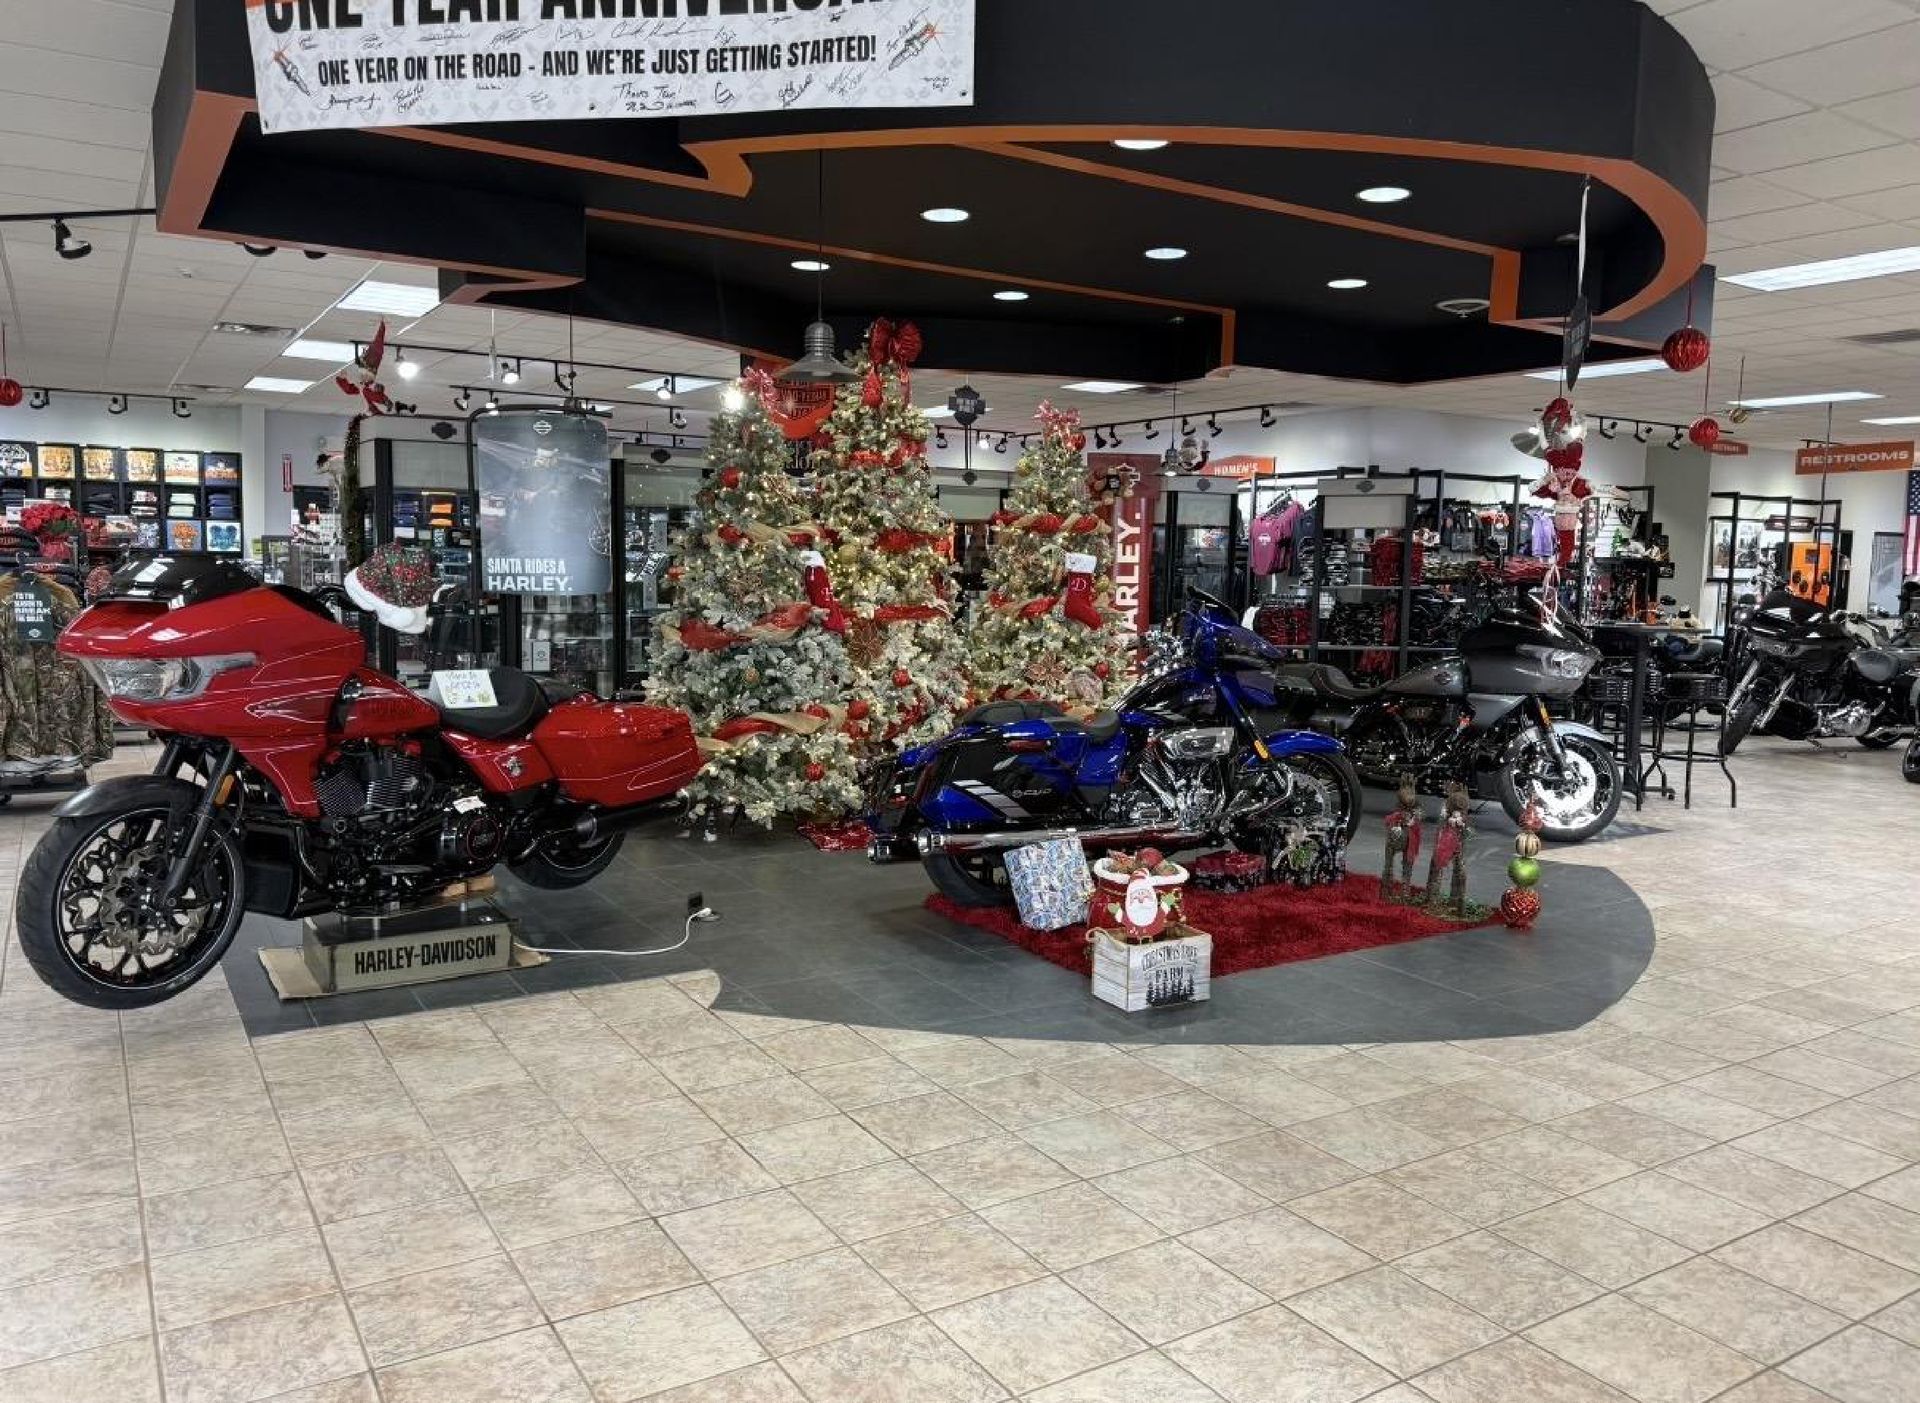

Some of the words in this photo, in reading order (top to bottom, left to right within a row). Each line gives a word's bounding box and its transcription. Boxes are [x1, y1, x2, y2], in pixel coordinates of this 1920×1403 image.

[318, 60, 350, 86] ONE
[355, 57, 399, 84] YEAR
[404, 55, 428, 81] ON
[434, 54, 466, 80] THE
[472, 52, 521, 78] ROAD
[542, 50, 579, 76] AND
[587, 48, 645, 75] WE'RE
[652, 48, 699, 74] JUST
[706, 43, 781, 73] GETTING
[787, 35, 877, 66] STARTED!
[1801, 450, 1909, 467] RESTROOMS
[1214, 462, 1259, 476] WOMEN'S
[487, 557, 522, 574] SANTA
[525, 557, 556, 574] RIDES
[558, 557, 566, 574] A
[488, 575, 573, 592] HARLEY.
[1115, 511, 1142, 652] ARLEY.
[355, 934, 497, 975] HARLEY-DAVIDSON
